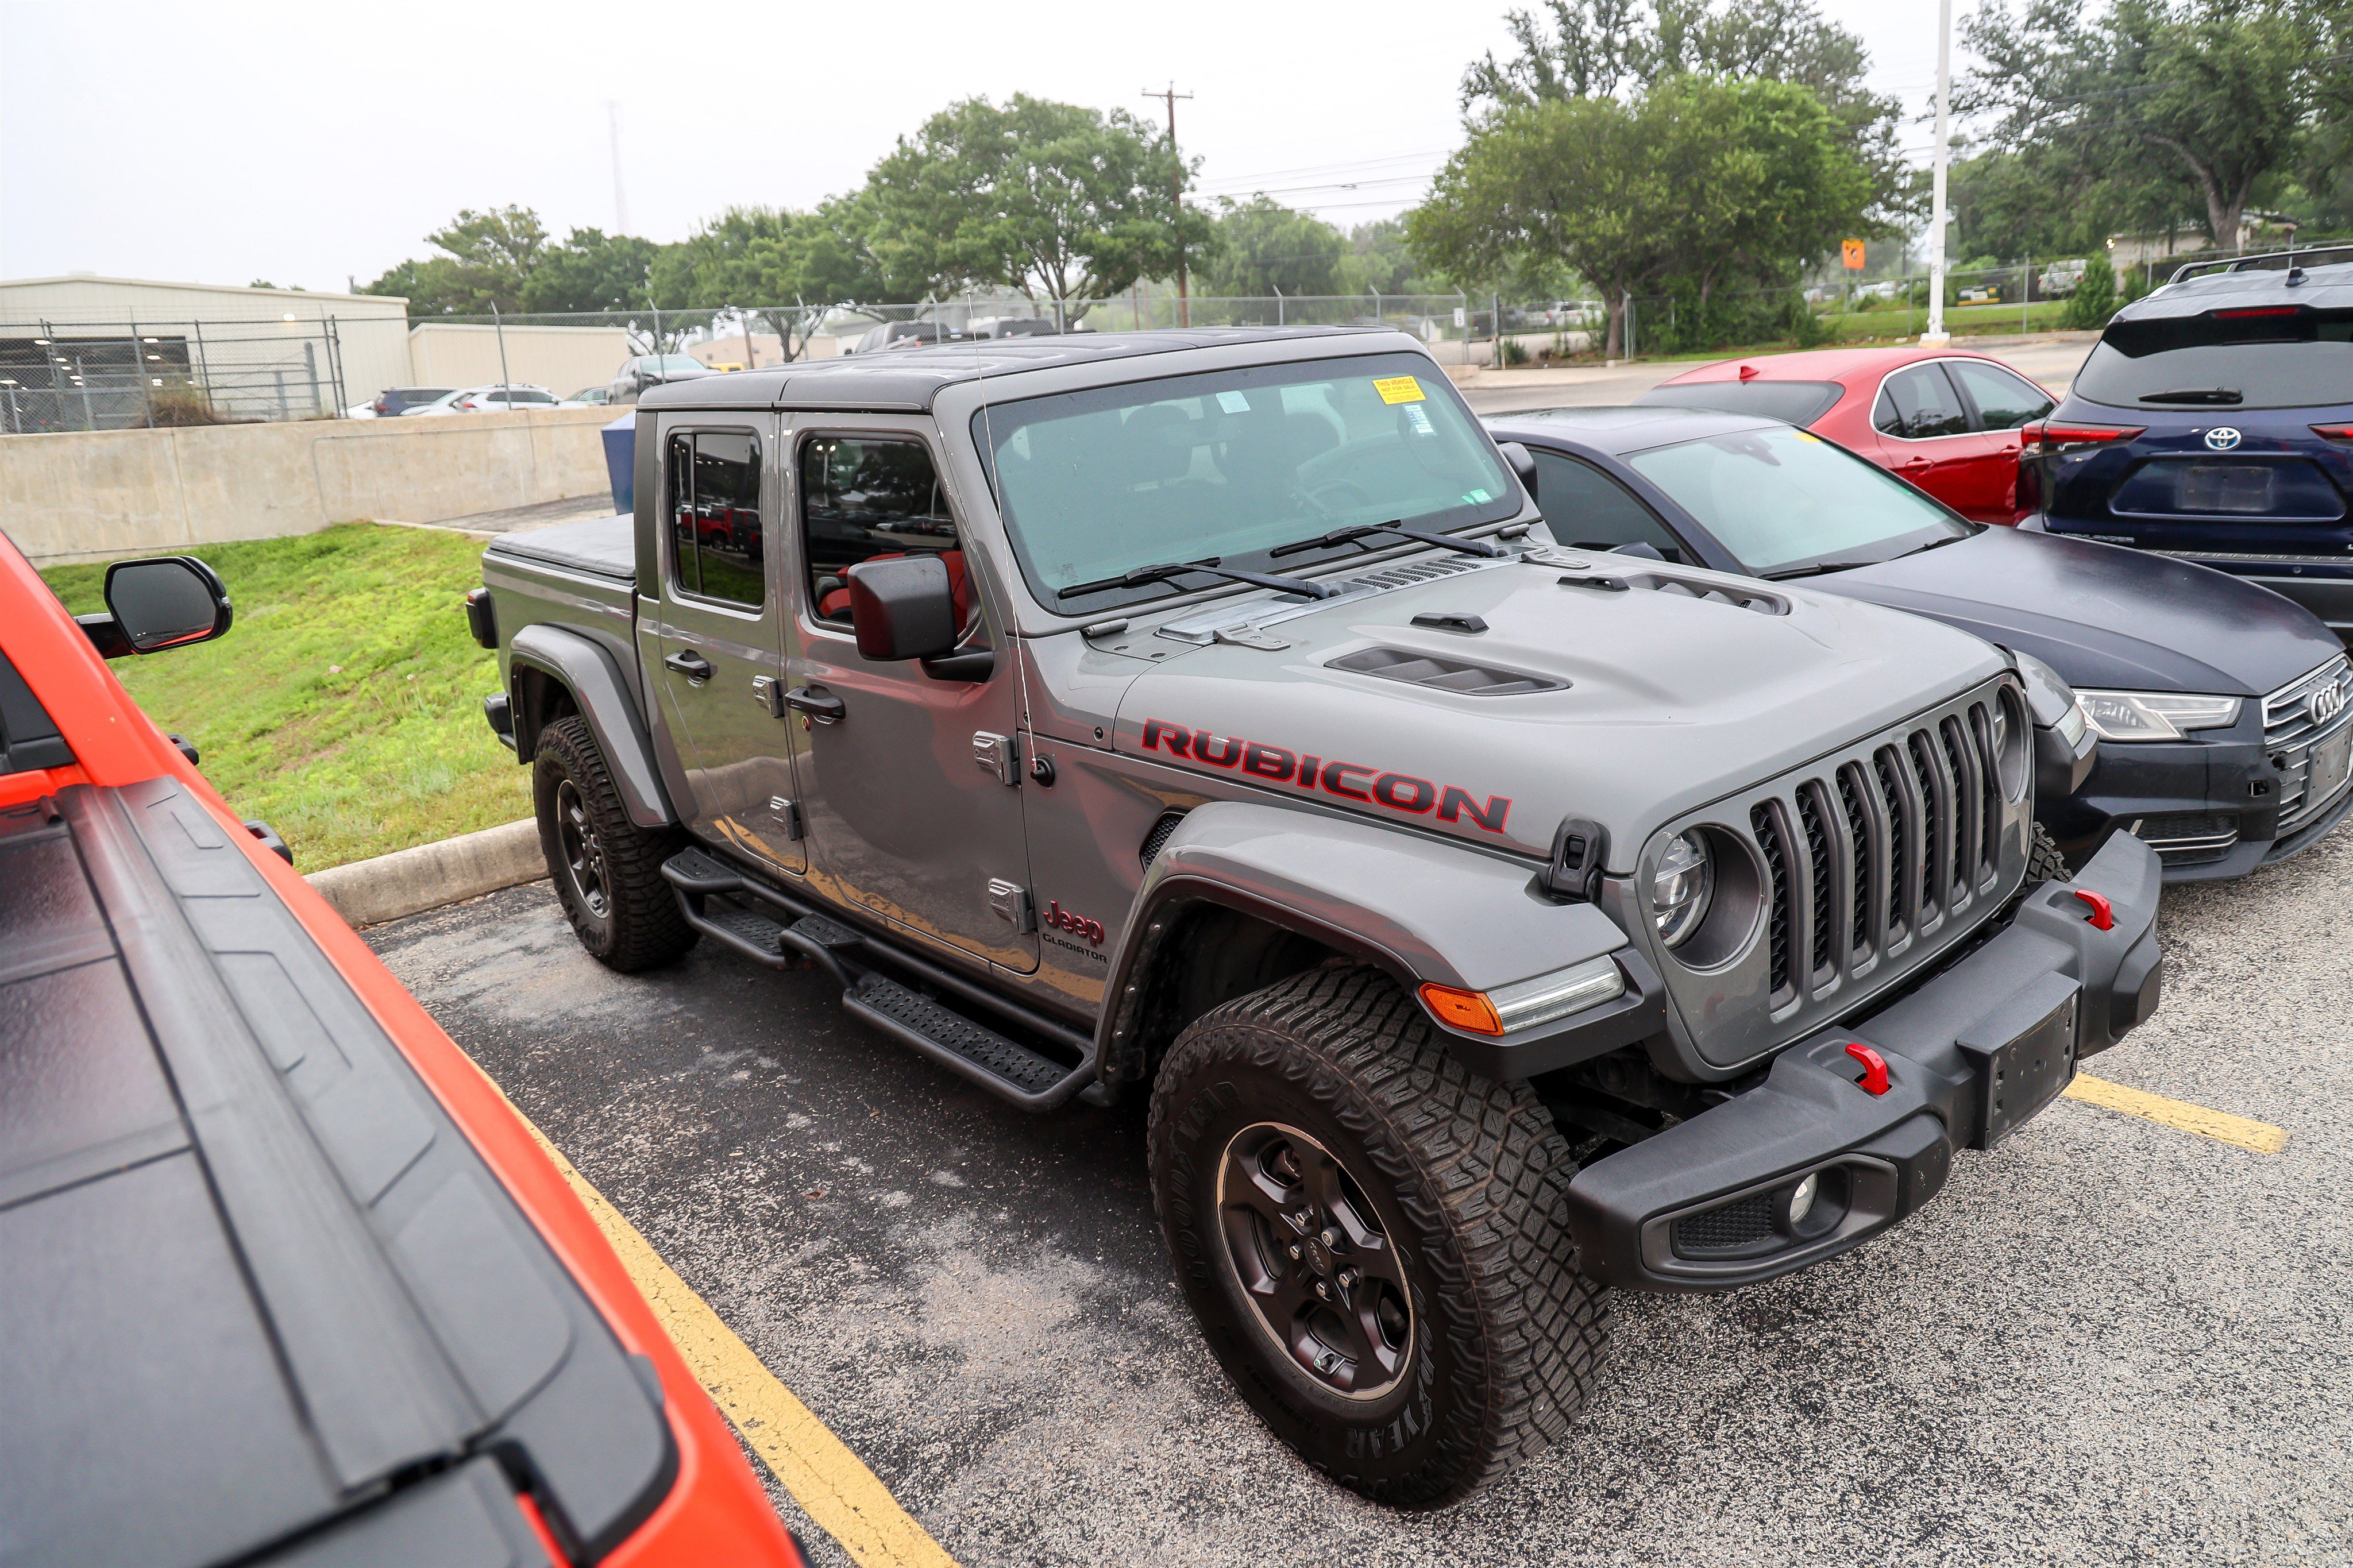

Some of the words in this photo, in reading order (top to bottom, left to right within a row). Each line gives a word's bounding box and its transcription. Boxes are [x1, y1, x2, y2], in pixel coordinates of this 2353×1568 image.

[1390, 377, 1414, 385] VEHICLE
[1141, 717, 1512, 834] RUBICON
[1043, 899, 1104, 948] Jeep
[1042, 932, 1108, 964] GLADIATOR
